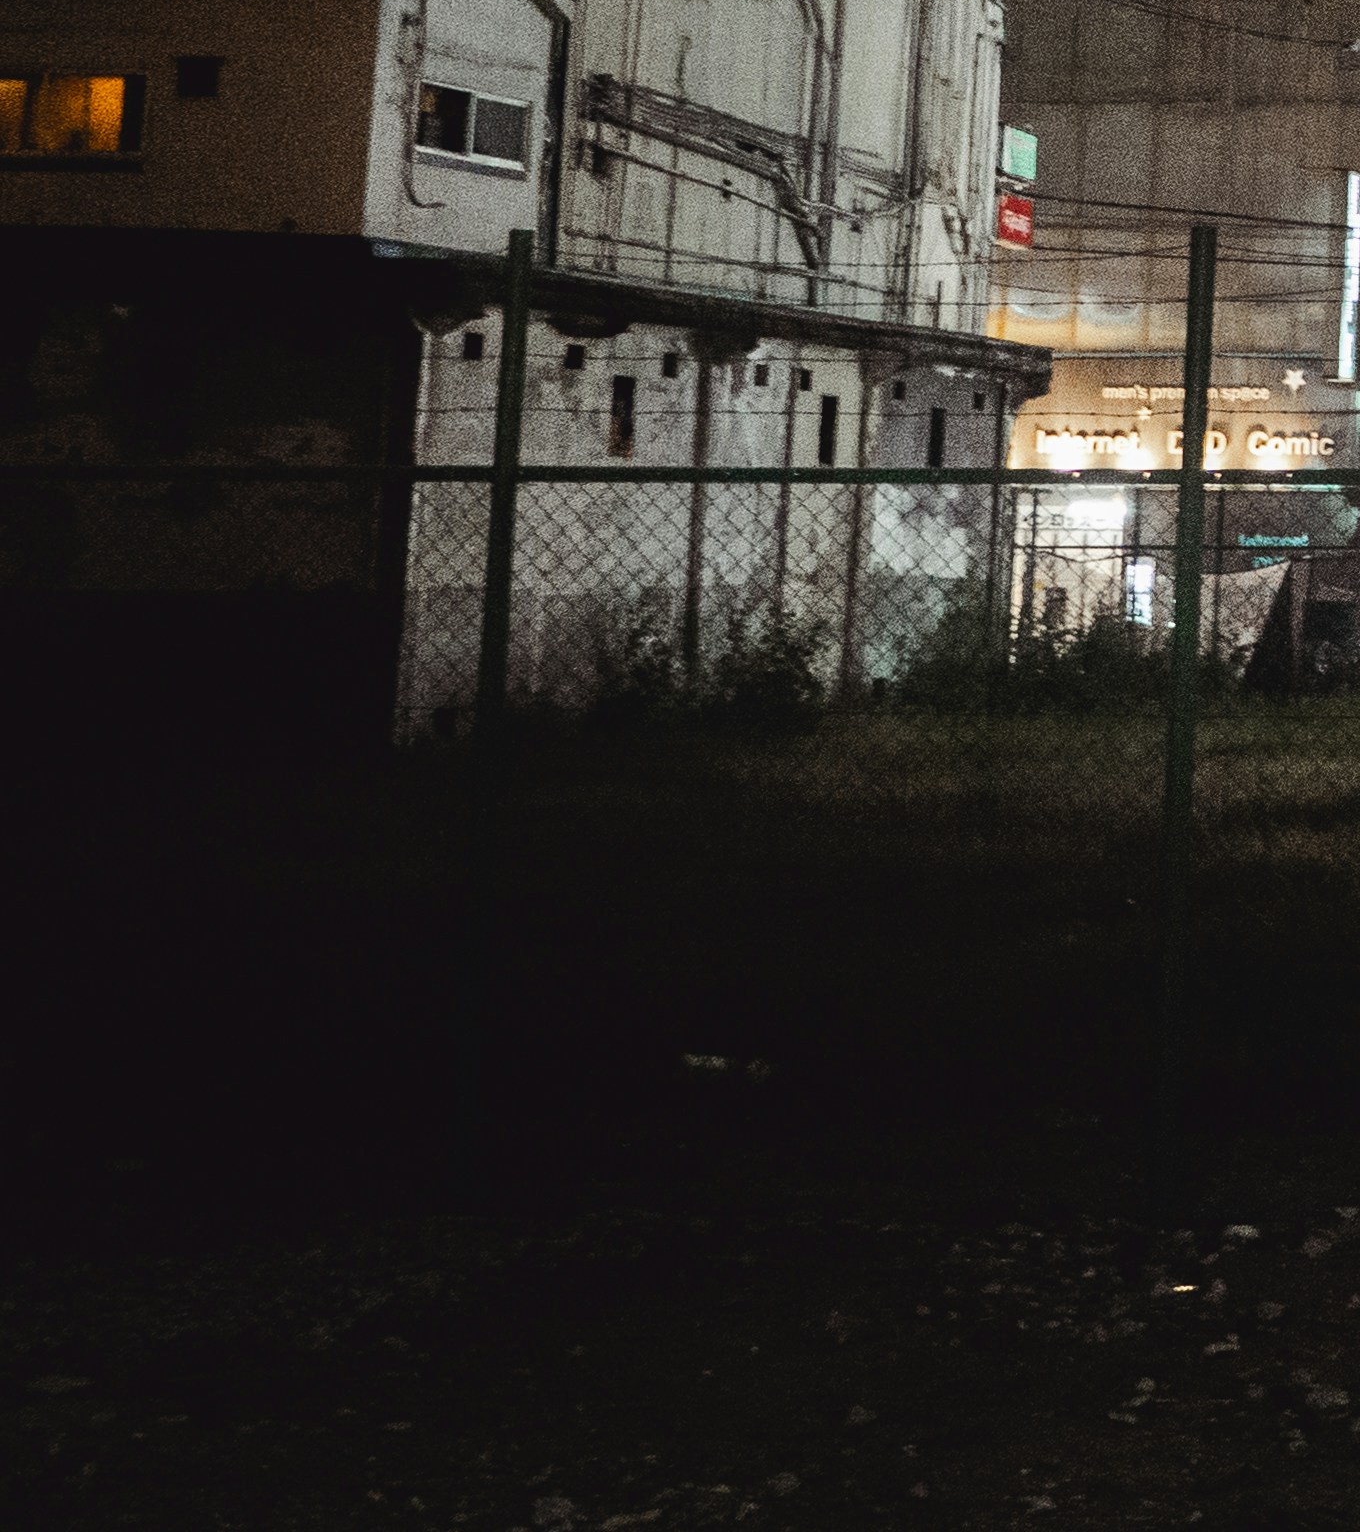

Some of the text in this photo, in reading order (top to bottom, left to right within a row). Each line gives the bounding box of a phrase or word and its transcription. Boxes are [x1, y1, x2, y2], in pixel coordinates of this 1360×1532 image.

[1102, 385, 1270, 402] men's premm space
[1036, 430, 1335, 456] Internet DD Comic
